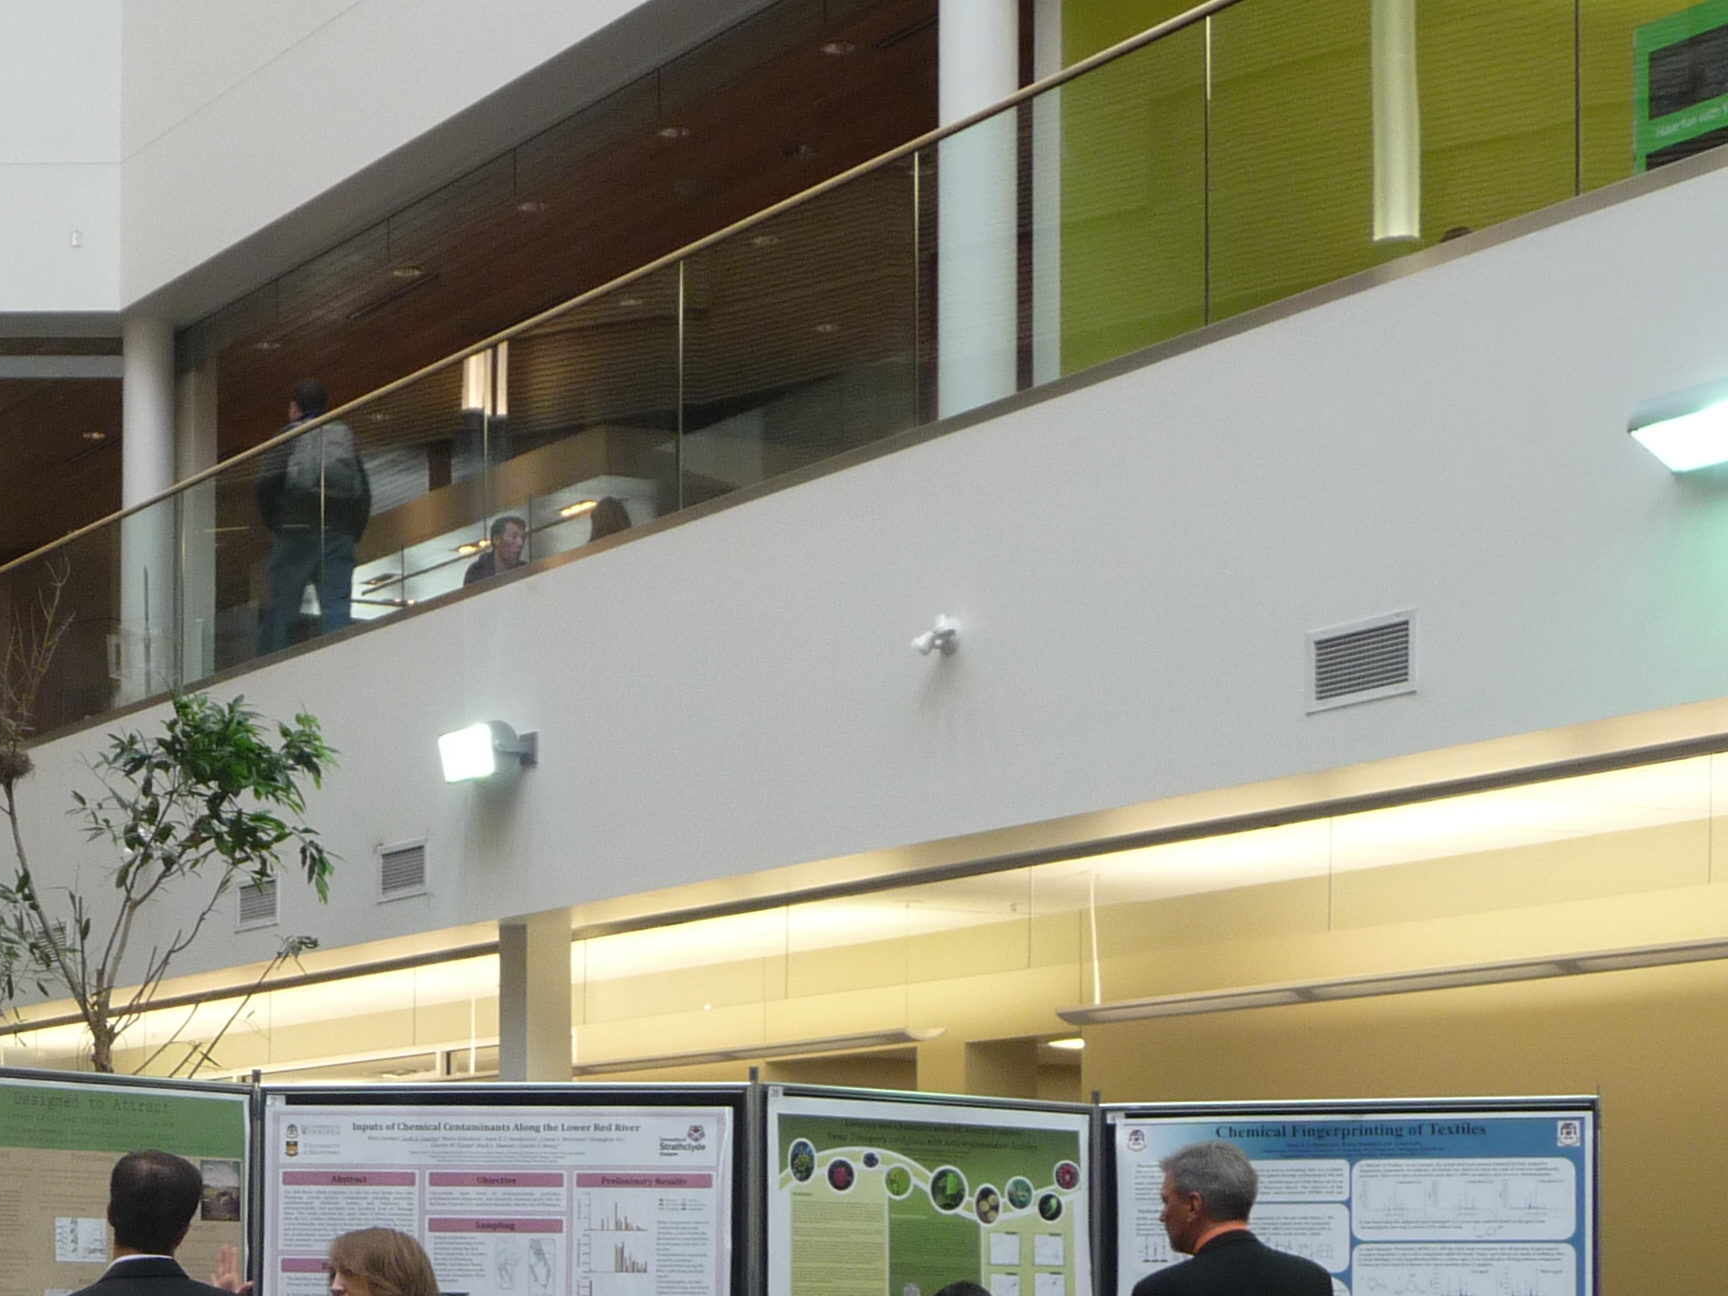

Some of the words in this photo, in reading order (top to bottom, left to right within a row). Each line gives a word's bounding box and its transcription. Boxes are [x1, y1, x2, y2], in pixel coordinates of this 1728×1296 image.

[14, 1091, 79, 1111] Designed
[89, 1098, 104, 1110] to
[113, 1098, 170, 1113] Attract
[352, 1122, 383, 1132] Inputs
[385, 1122, 396, 1131] of
[397, 1122, 441, 1131] Chemical
[443, 1122, 510, 1132] Contaminants
[512, 1123, 541, 1133] Along
[543, 1123, 559, 1132] the
[561, 1123, 591, 1132] Lower
[593, 1124, 613, 1132] Red
[614, 1124, 641, 1132] River
[1215, 1125, 1286, 1138] Chemical
[1292, 1123, 1404, 1140] Fingerprinting
[1408, 1123, 1424, 1136] of
[1428, 1122, 1487, 1136] Textiles
[659, 1142, 706, 1152] Strathclyde
[331, 1175, 367, 1183] Abstract
[476, 1176, 517, 1186] Objective
[601, 1176, 652, 1187] Preliminary
[654, 1177, 688, 1185] Results
[475, 1221, 516, 1231] Sampling
